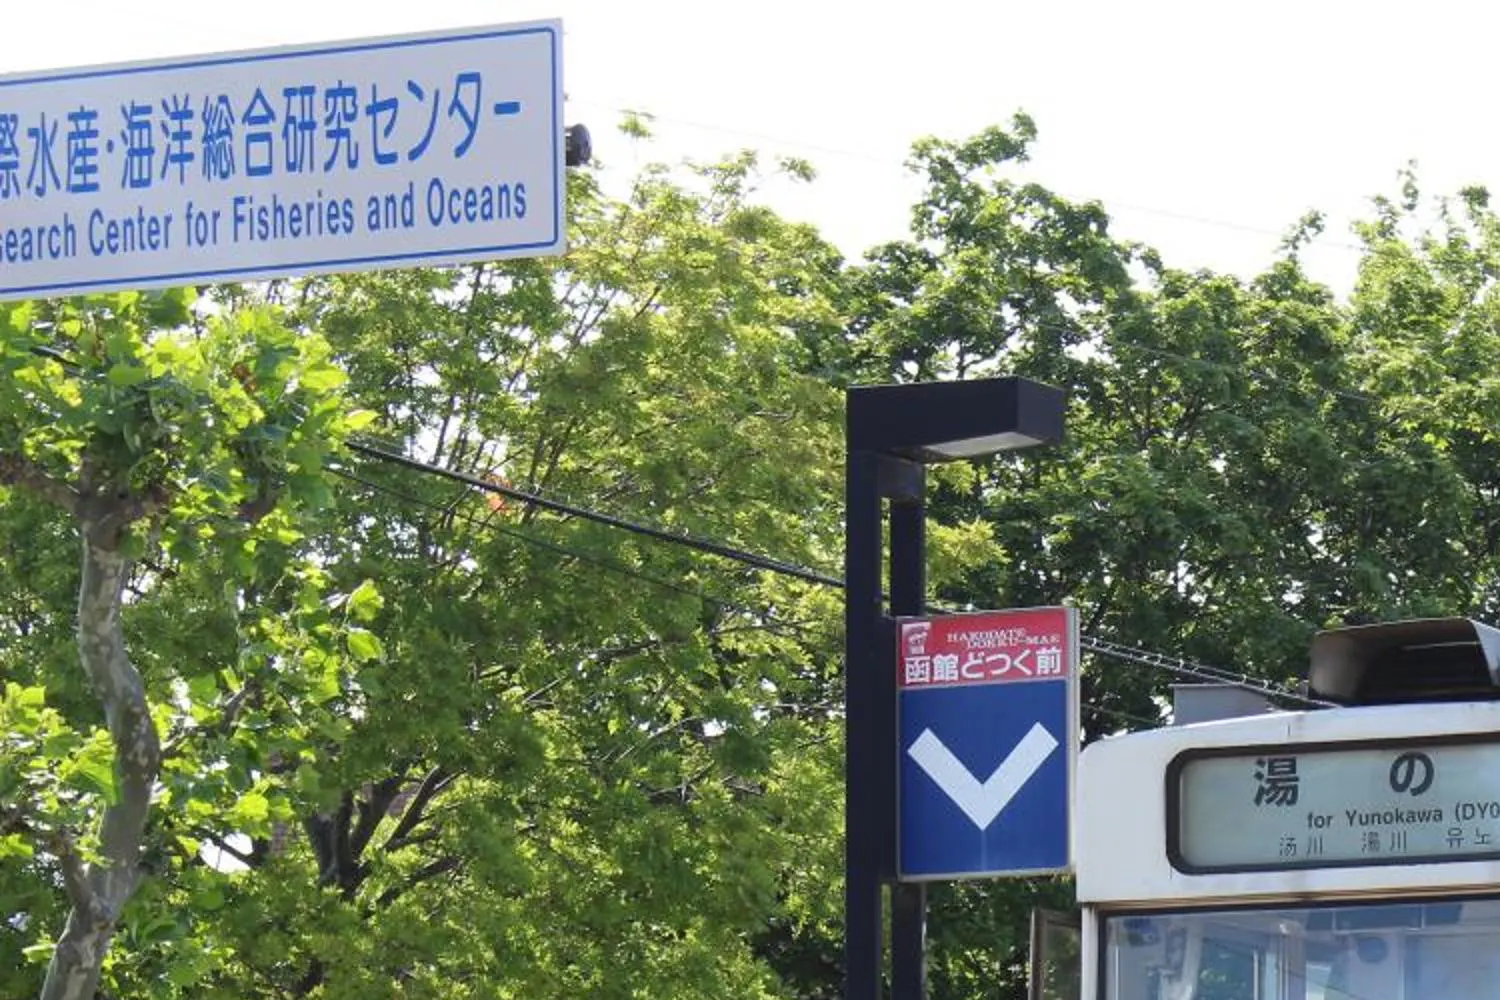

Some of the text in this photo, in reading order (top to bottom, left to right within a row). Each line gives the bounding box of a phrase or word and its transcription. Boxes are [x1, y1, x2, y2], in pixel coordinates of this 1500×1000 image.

[0, 177, 527, 262] earch Center for Fisheries and Oceans
[1307, 812, 1333, 829] for
[1345, 808, 1444, 828] Yunokawa
